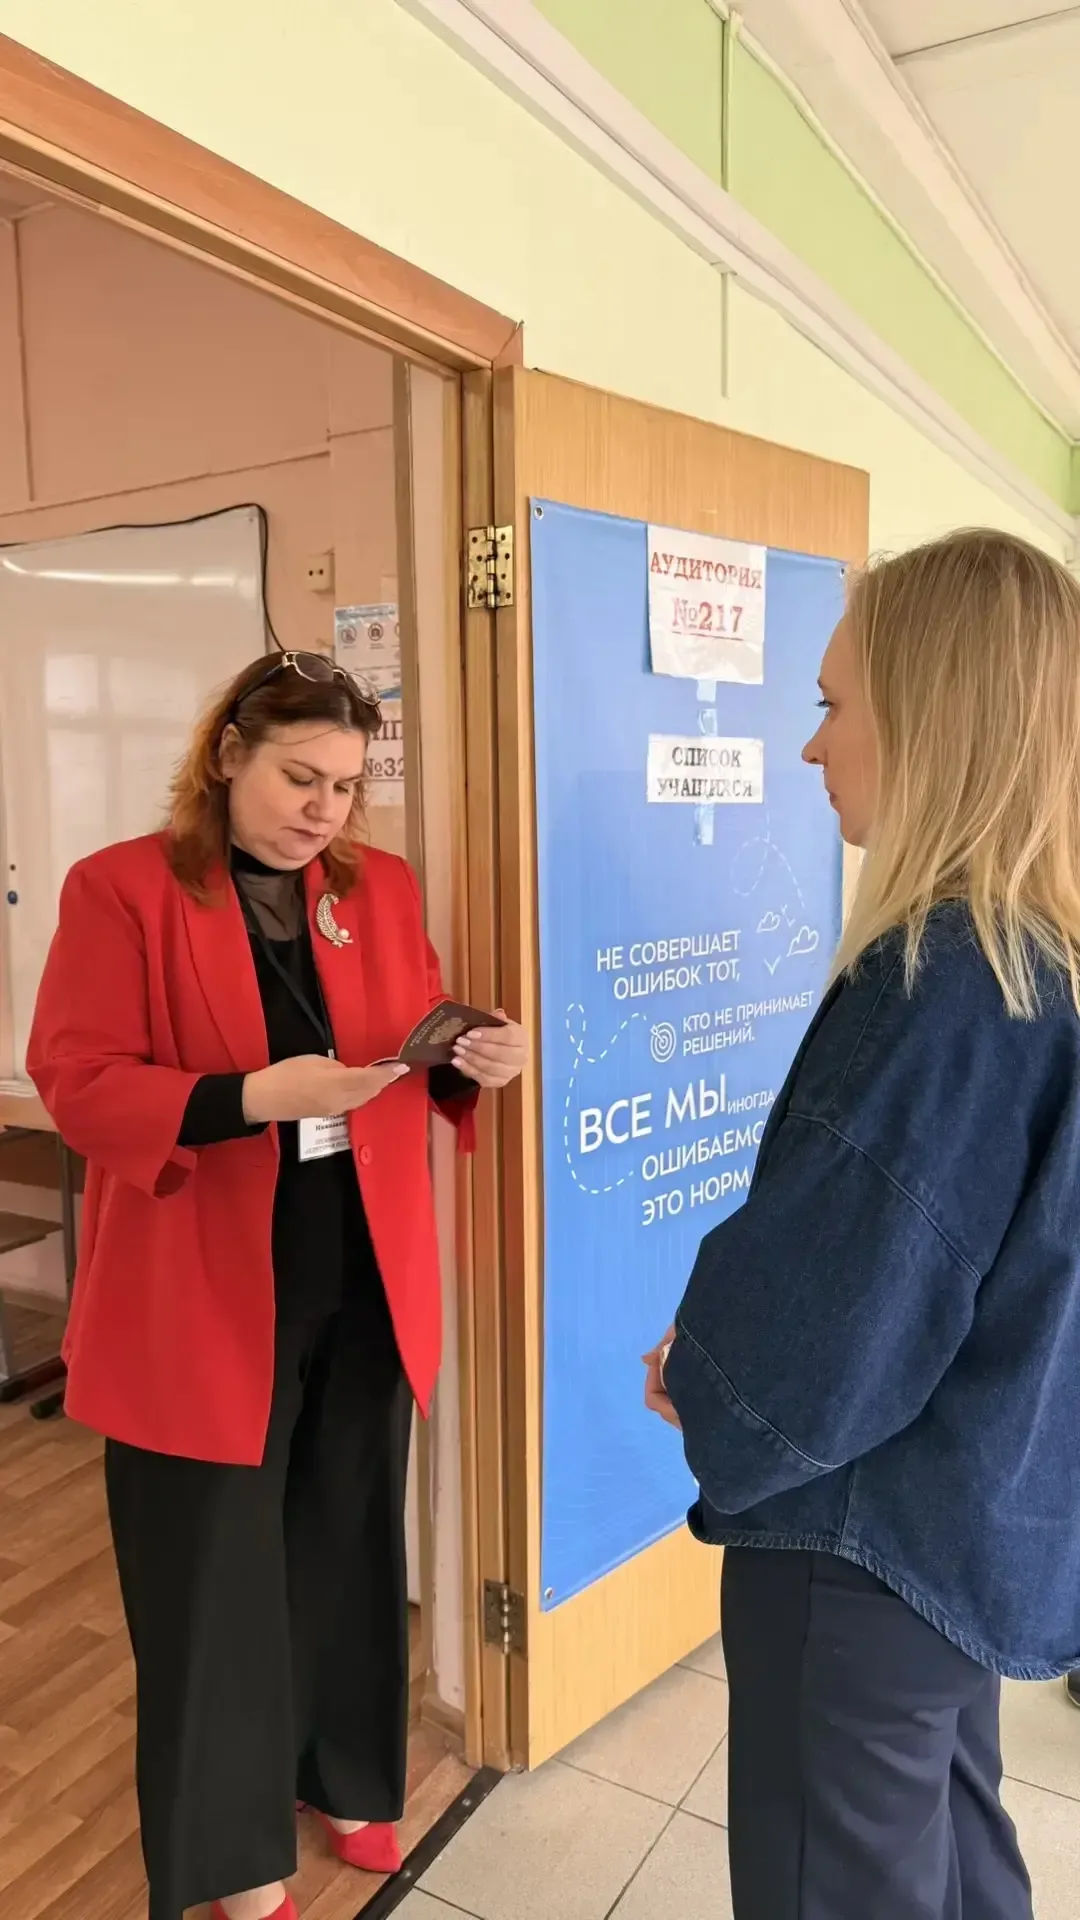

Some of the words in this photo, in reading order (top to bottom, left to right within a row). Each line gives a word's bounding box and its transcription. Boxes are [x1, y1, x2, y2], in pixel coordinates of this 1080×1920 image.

[650, 551, 762, 589] АУДИТОРИЯ
[672, 597, 743, 633] №217
[672, 746, 741, 768] СПИСОК
[657, 778, 753, 799] УЧАЩИХСЯ
[596, 946, 623, 972] НЕ
[629, 930, 742, 966] СОВЕРШАЕТ
[613, 967, 703, 1000] ОШИБОК
[707, 958, 741, 983] ТОТ,
[683, 1013, 711, 1034] КТО
[714, 1008, 733, 1026] НЕ
[736, 991, 814, 1021] ПРИНИМАЕТ
[683, 1024, 755, 1056] РЕШЕНИЙ.
[580, 1093, 652, 1154] ВСЕ
[665, 1073, 726, 1129] МЫ
[642, 1120, 767, 1181] ОШИБАЕМС
[642, 1189, 683, 1226] ЭТО
[690, 1165, 752, 1208] НОРМ
